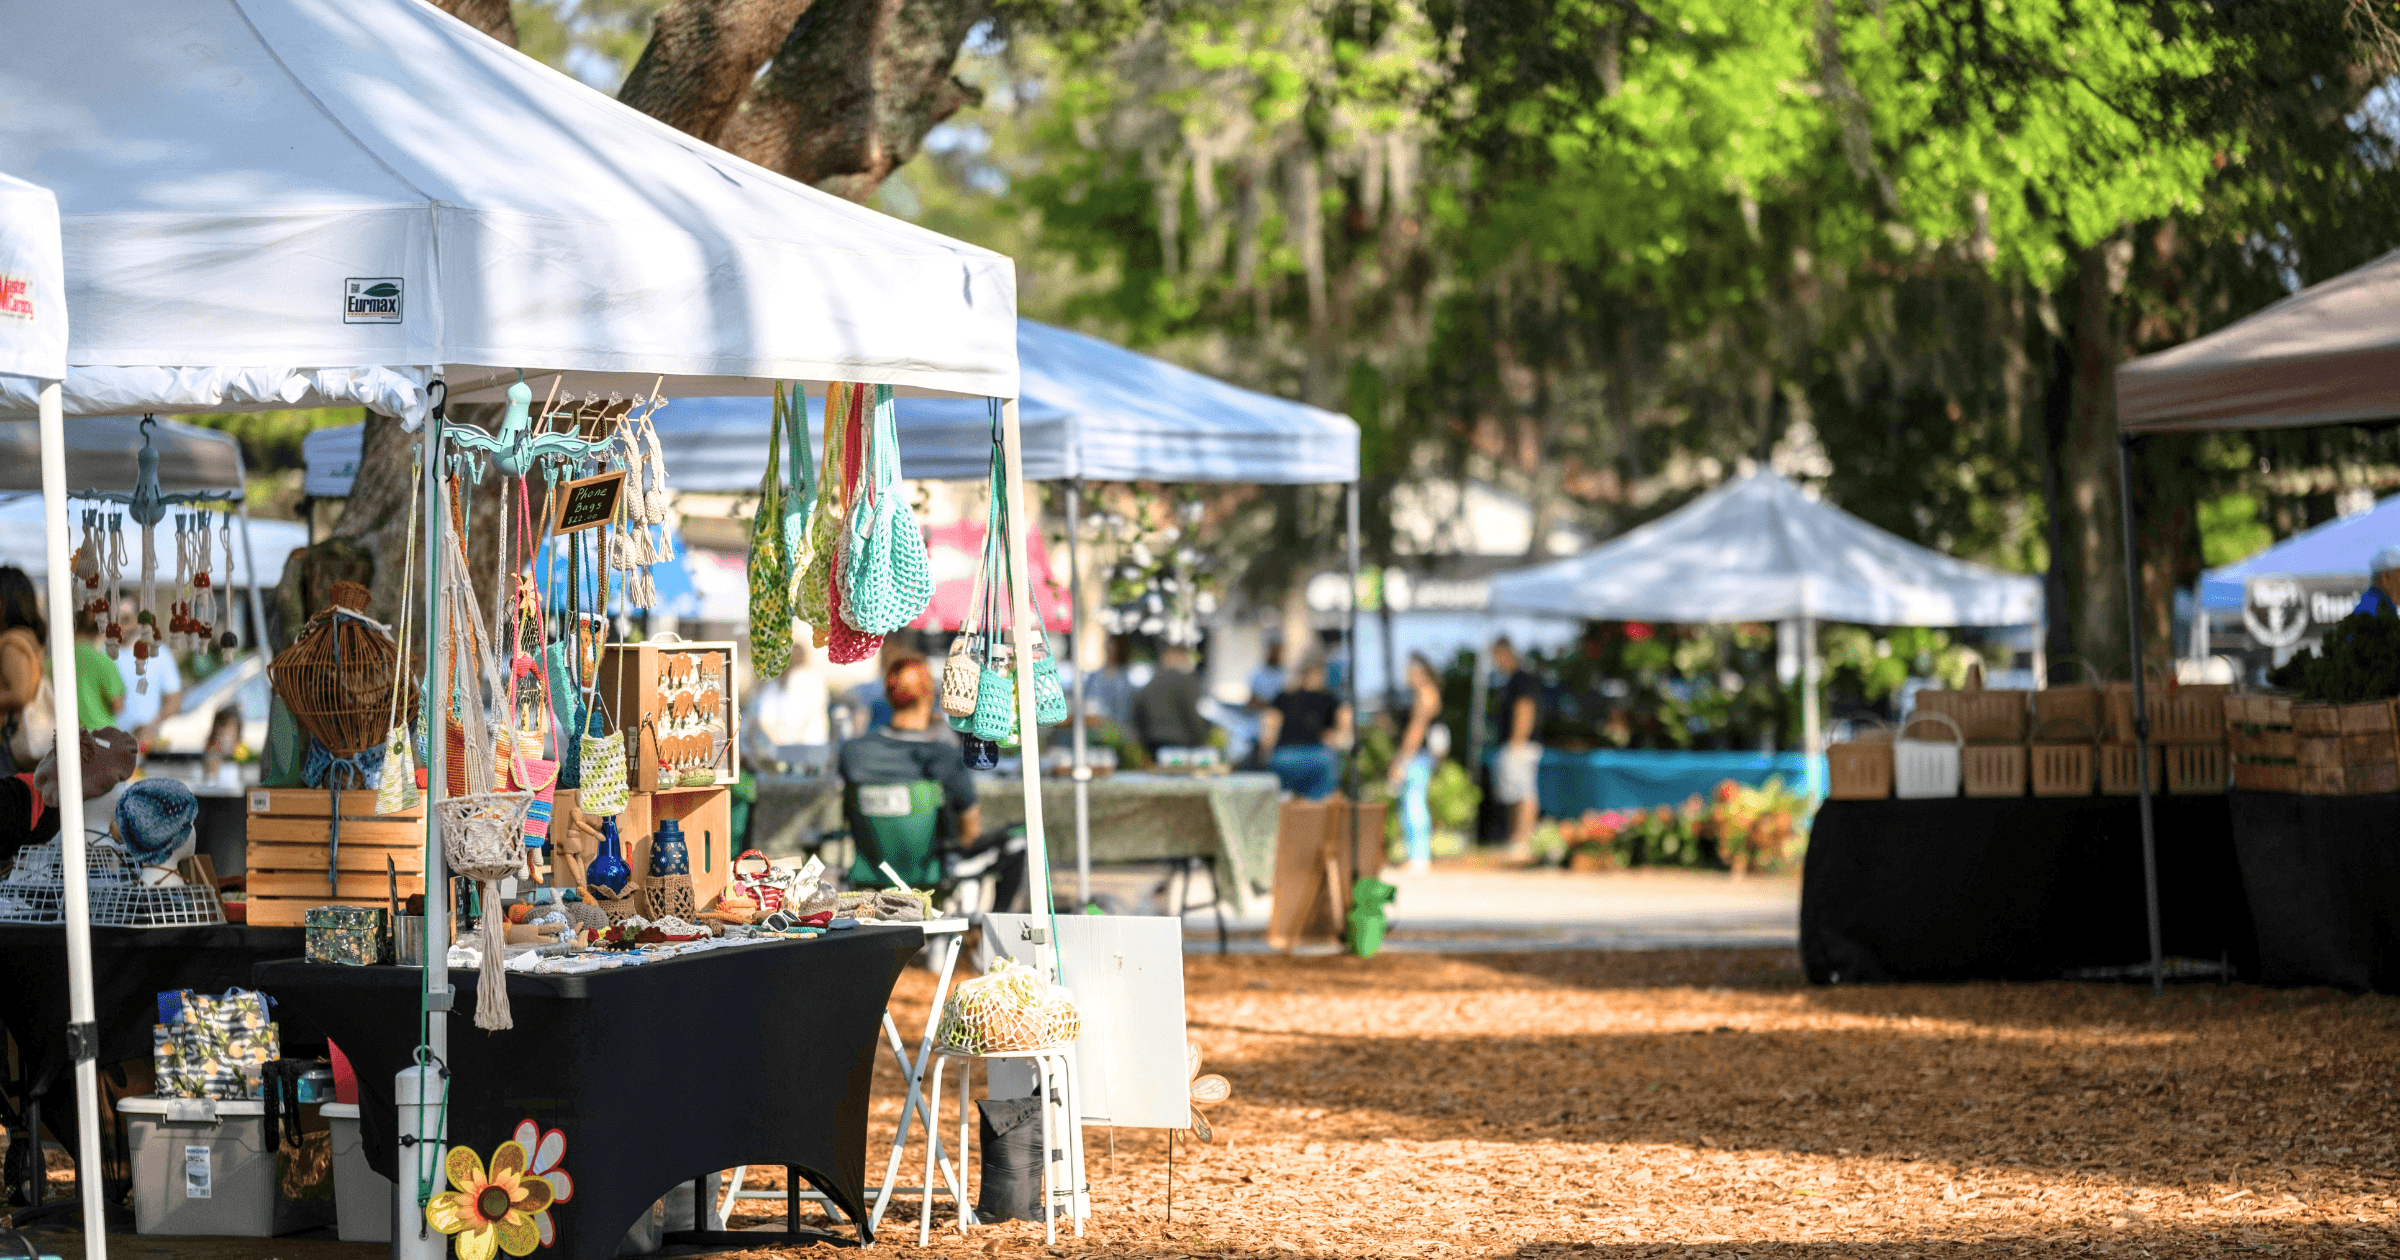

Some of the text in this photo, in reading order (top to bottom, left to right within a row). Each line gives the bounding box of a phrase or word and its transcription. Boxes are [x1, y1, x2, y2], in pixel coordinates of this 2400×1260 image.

[348, 295, 396, 312] Eurmax
[574, 487, 608, 502] Phone
[574, 502, 602, 513] Bags
[567, 513, 598, 525] $22.00
